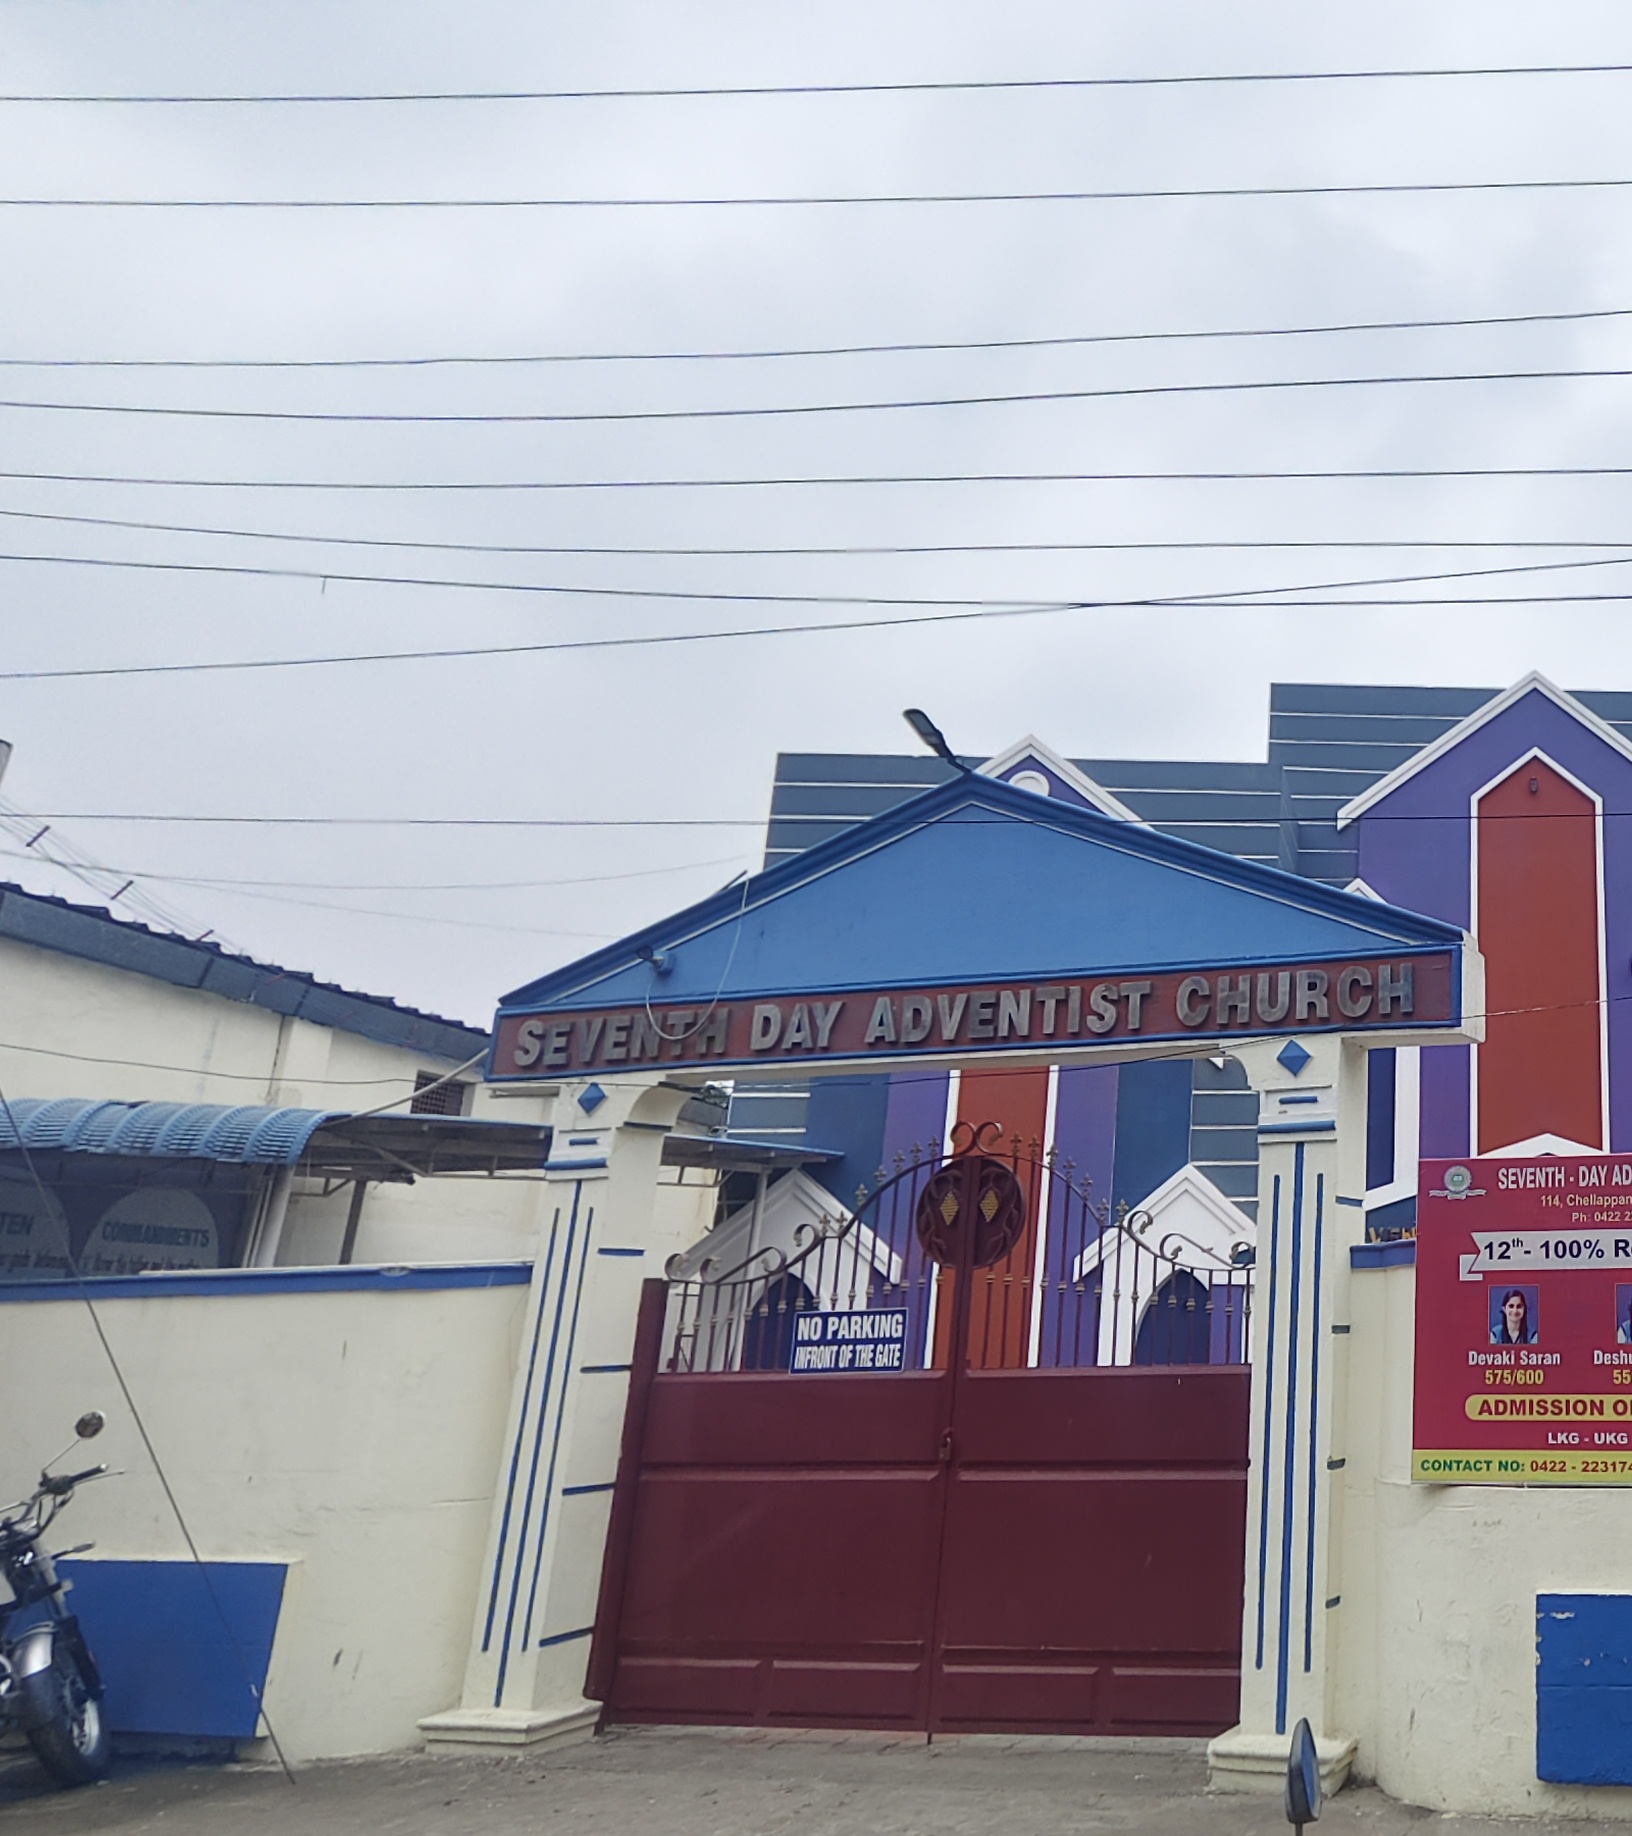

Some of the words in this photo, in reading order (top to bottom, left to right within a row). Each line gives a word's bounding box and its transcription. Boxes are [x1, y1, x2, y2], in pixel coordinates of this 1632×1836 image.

[514, 1007, 729, 1066] SEVENTH
[750, 1000, 846, 1051] DAY
[864, 980, 1152, 1044] ADVENTIST
[1176, 963, 1414, 1027] CHURCH
[1498, 1166, 1565, 1189] SEVENTH
[1579, 1165, 1608, 1187] DAY
[1540, 1195, 1563, 1209] 114,
[1566, 1194, 1632, 1208] Chellappan
[1572, 1212, 1590, 1222] Ph:
[1594, 1211, 1621, 1222] 0422
[1539, 1239, 1605, 1260] 100%
[797, 1317, 822, 1341] NO
[827, 1313, 903, 1339] PARKING
[794, 1345, 838, 1369] INFRONT
[838, 1344, 853, 1368] OF
[854, 1344, 875, 1367] THE
[875, 1343, 901, 1367] GATE
[1468, 1350, 1515, 1365] Devaki
[1520, 1350, 1561, 1365] Saran
[1485, 1369, 1544, 1386] 575/600
[1478, 1399, 1605, 1416] ADMISSION
[1548, 1432, 1580, 1444] LKG
[1594, 1432, 1628, 1444] UKG
[1420, 1459, 1493, 1472] CONTACT
[1499, 1460, 1525, 1472] NO:
[1530, 1460, 1567, 1473] 0422
